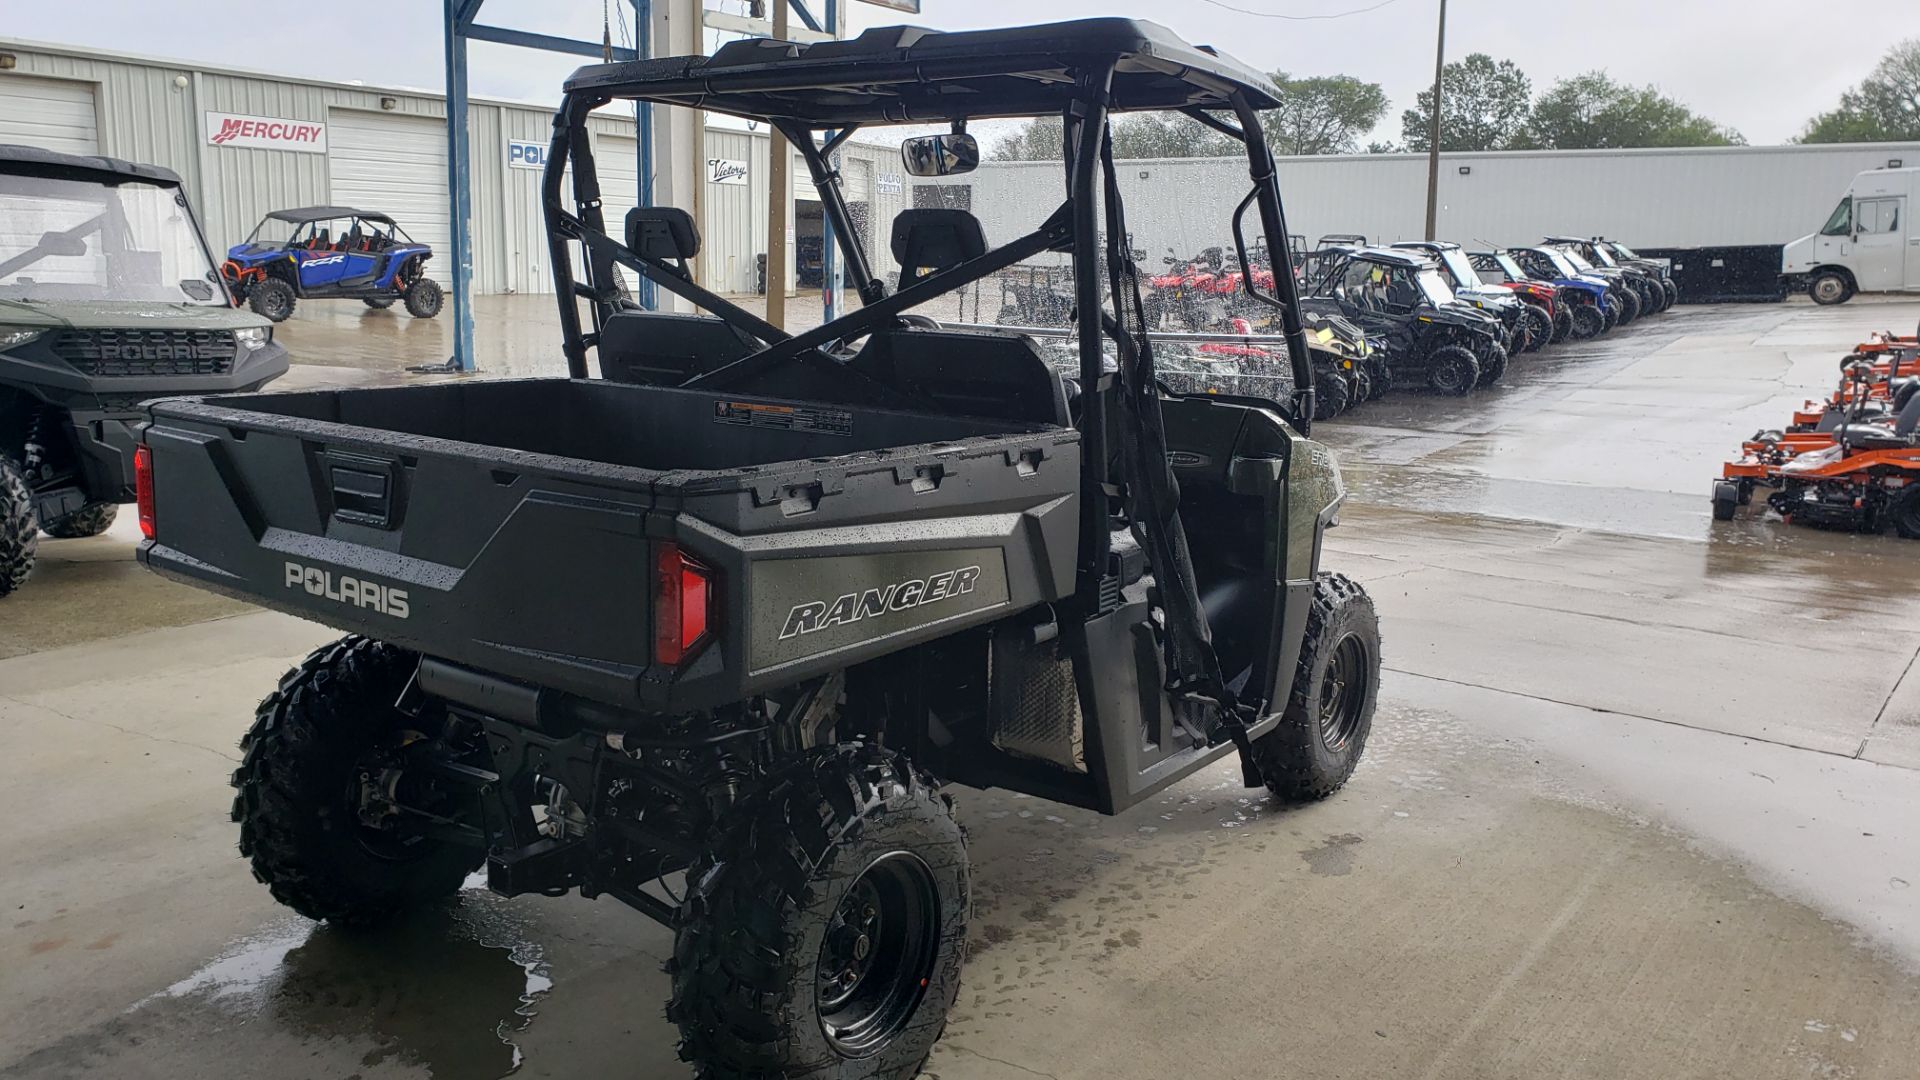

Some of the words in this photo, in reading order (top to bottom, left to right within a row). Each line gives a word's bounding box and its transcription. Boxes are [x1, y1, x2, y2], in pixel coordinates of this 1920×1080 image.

[212, 119, 321, 143] MERCURY
[708, 159, 745, 180] Victory
[301, 255, 344, 268] RZR
[101, 345, 214, 359] POLARIS
[285, 561, 410, 619] POLARIS
[778, 565, 981, 640] RANGER
